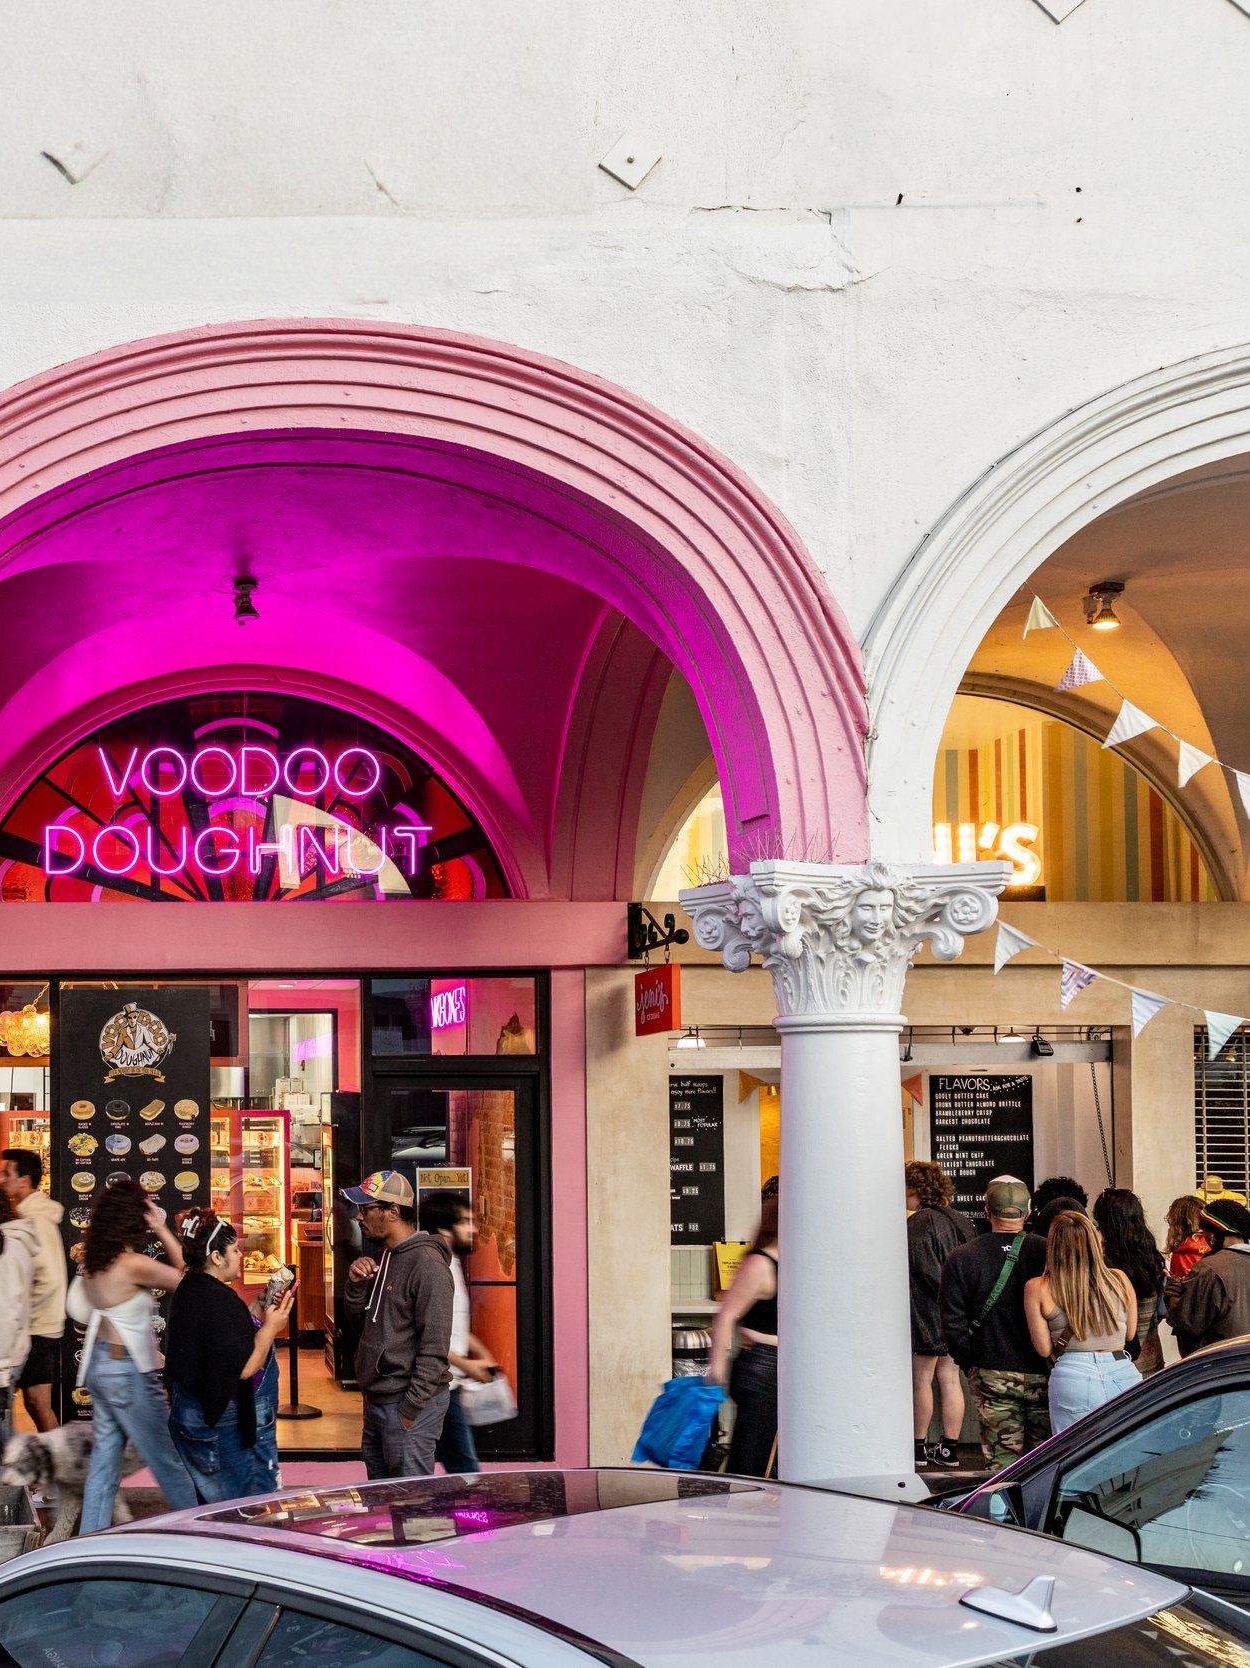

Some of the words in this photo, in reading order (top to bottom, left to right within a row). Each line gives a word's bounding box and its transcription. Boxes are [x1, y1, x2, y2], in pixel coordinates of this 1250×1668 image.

[98, 747, 380, 796] VOODOO
[45, 825, 434, 876] DOUGHNUT
[938, 1077, 990, 1091] FLAVORS
[420, 1173, 431, 1184] Not
